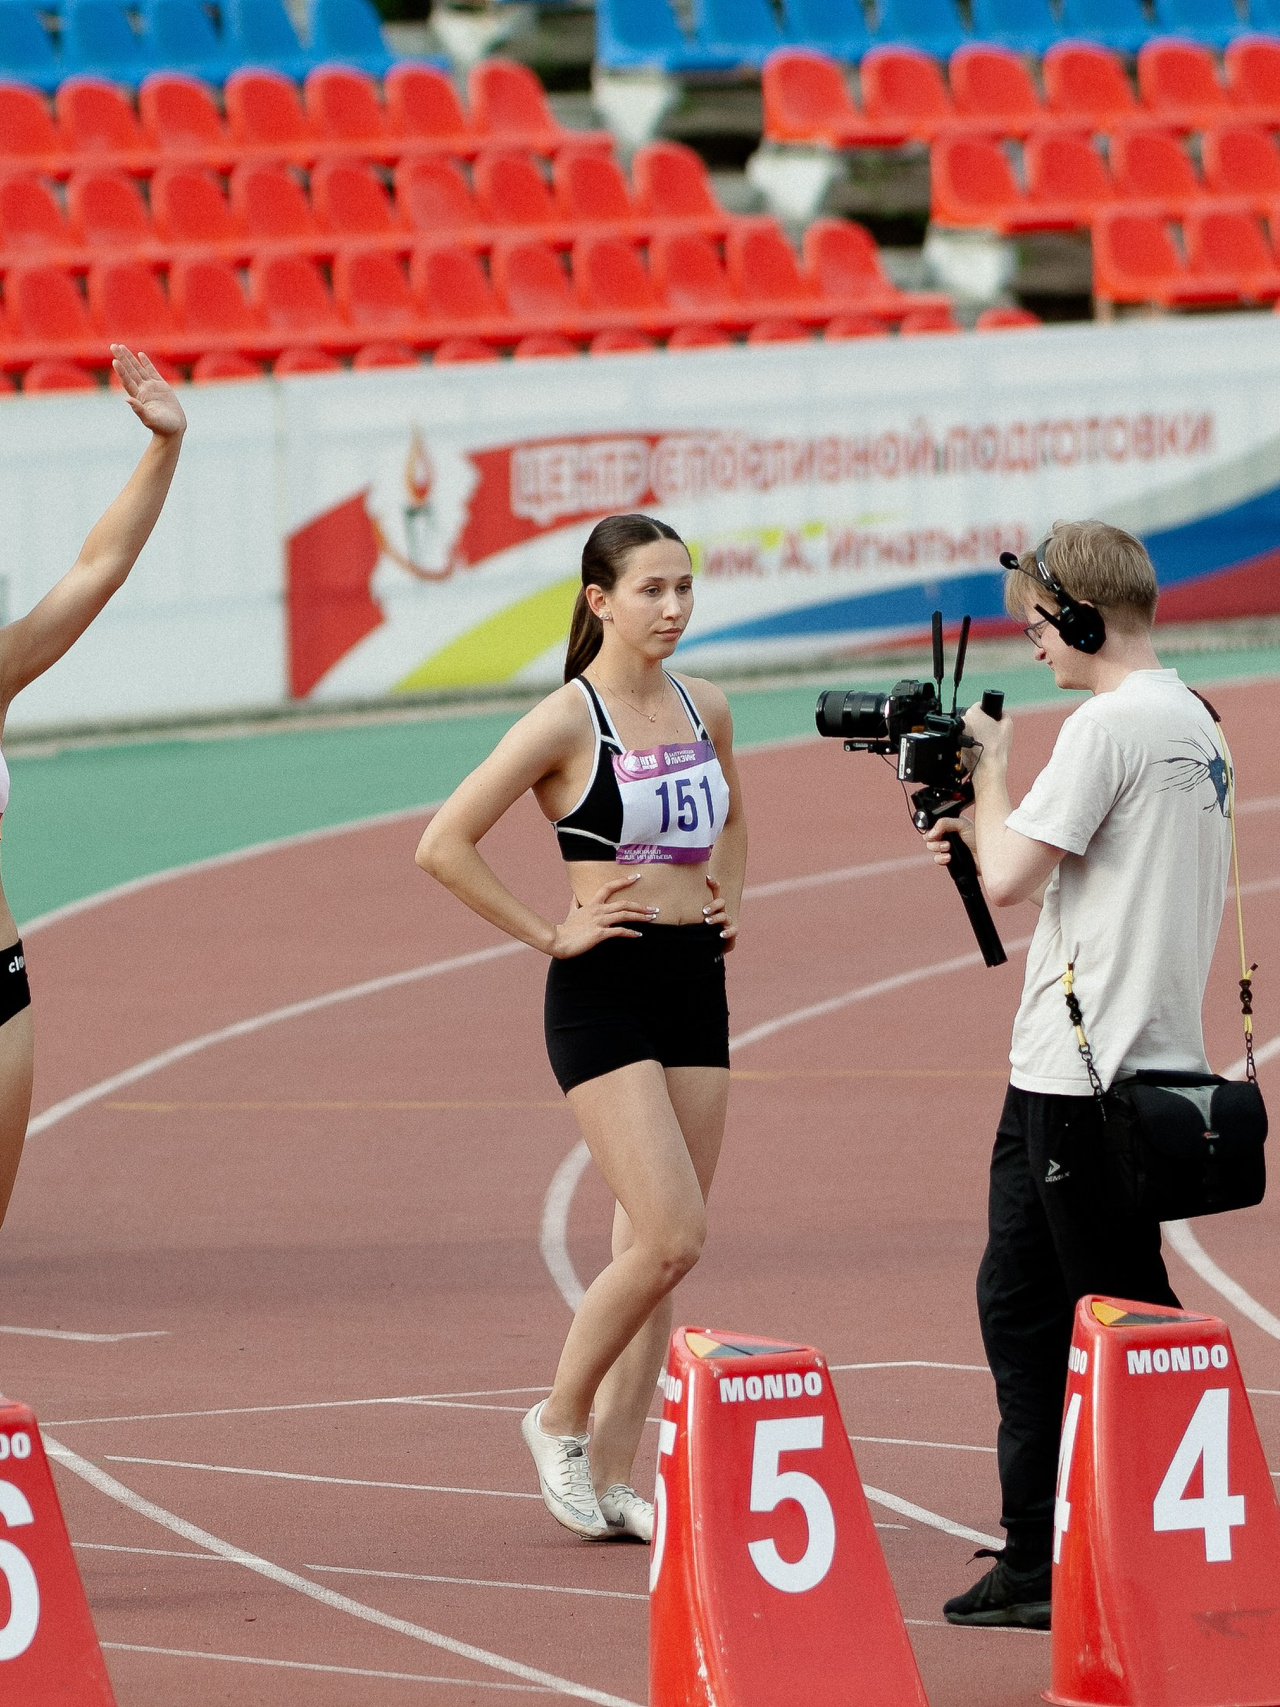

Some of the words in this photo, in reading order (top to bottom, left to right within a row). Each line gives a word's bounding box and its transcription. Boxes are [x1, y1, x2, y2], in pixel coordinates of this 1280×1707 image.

[655, 775, 715, 834] 151
[719, 1371, 823, 1404] MONDO
[1126, 1344, 1229, 1375] MONDO
[1153, 1387, 1246, 1562] 4
[747, 1415, 836, 1594] 5
